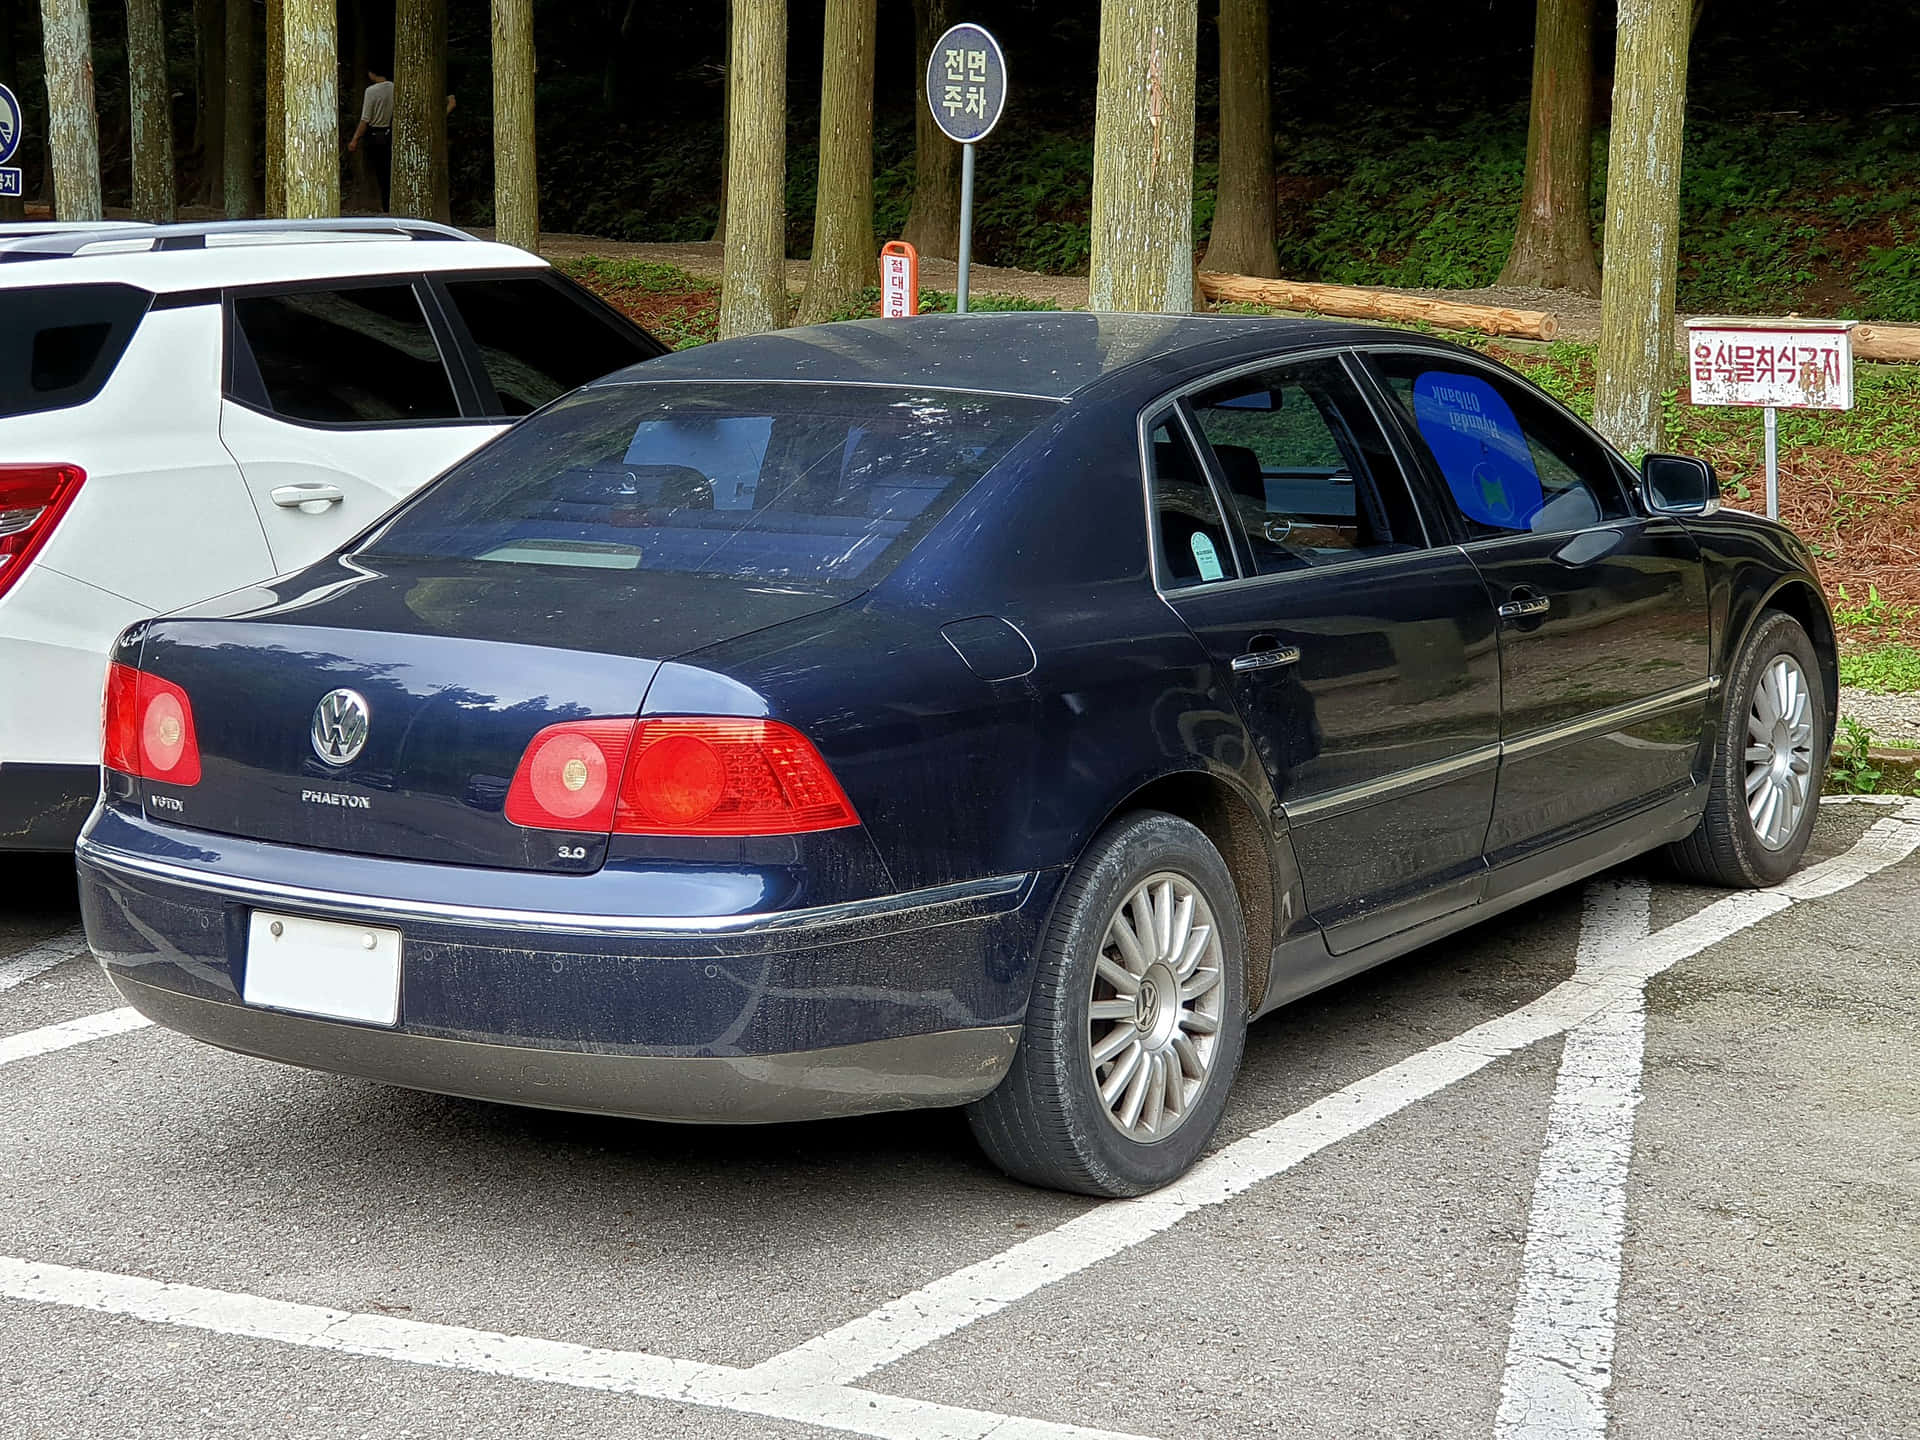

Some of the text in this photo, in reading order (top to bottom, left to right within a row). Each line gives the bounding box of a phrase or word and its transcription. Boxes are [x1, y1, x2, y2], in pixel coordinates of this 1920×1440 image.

[944, 49, 987, 82] 전면
[942, 85, 987, 119] 주차
[1432, 385, 1481, 412] Oilbank
[1449, 411, 1501, 439] Hyundai
[301, 789, 371, 809] PHAETON
[558, 846, 585, 859] 3.0
